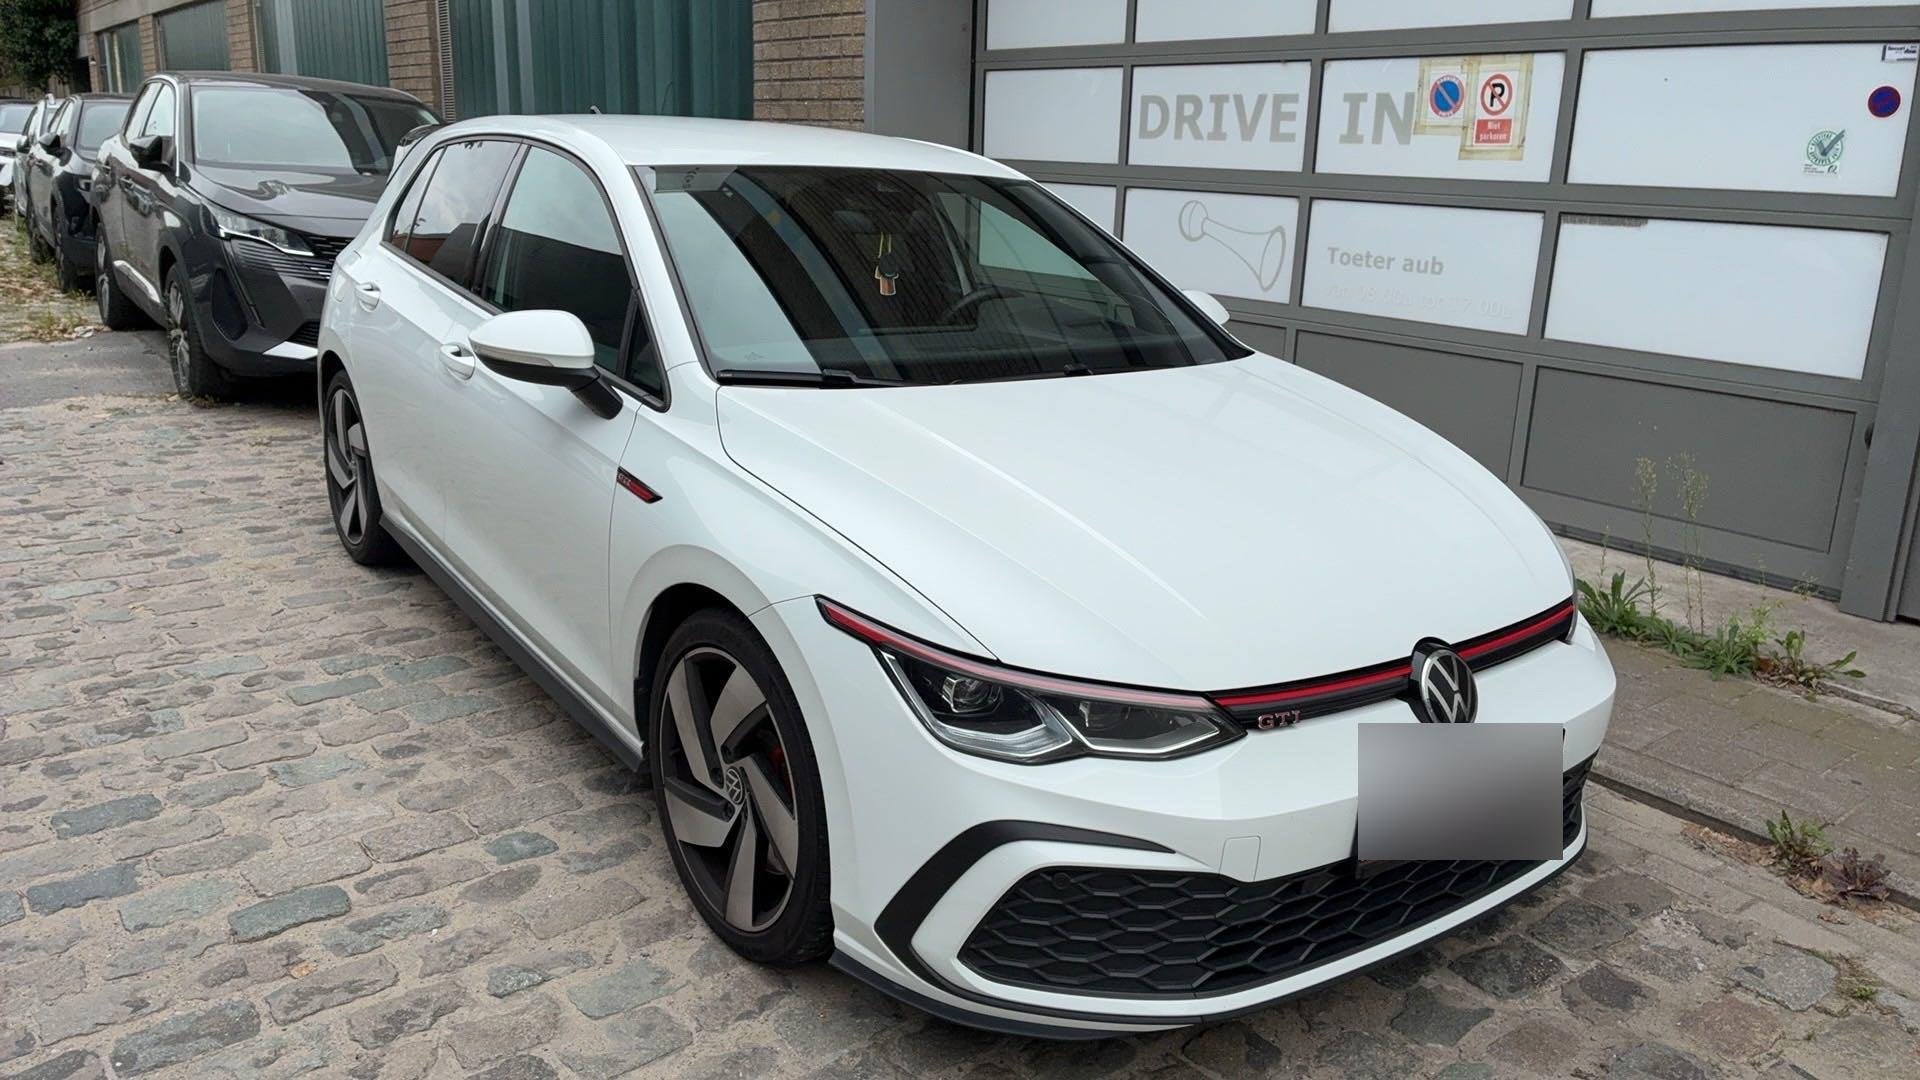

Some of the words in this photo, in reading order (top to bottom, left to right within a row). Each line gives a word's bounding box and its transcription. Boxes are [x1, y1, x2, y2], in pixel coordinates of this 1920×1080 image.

[1138, 93, 1299, 143] DRIVE
[1339, 91, 1416, 145] IN
[1327, 246, 1395, 270] Toeter
[1401, 255, 1444, 276] aub
[1258, 709, 1301, 730] GTI
